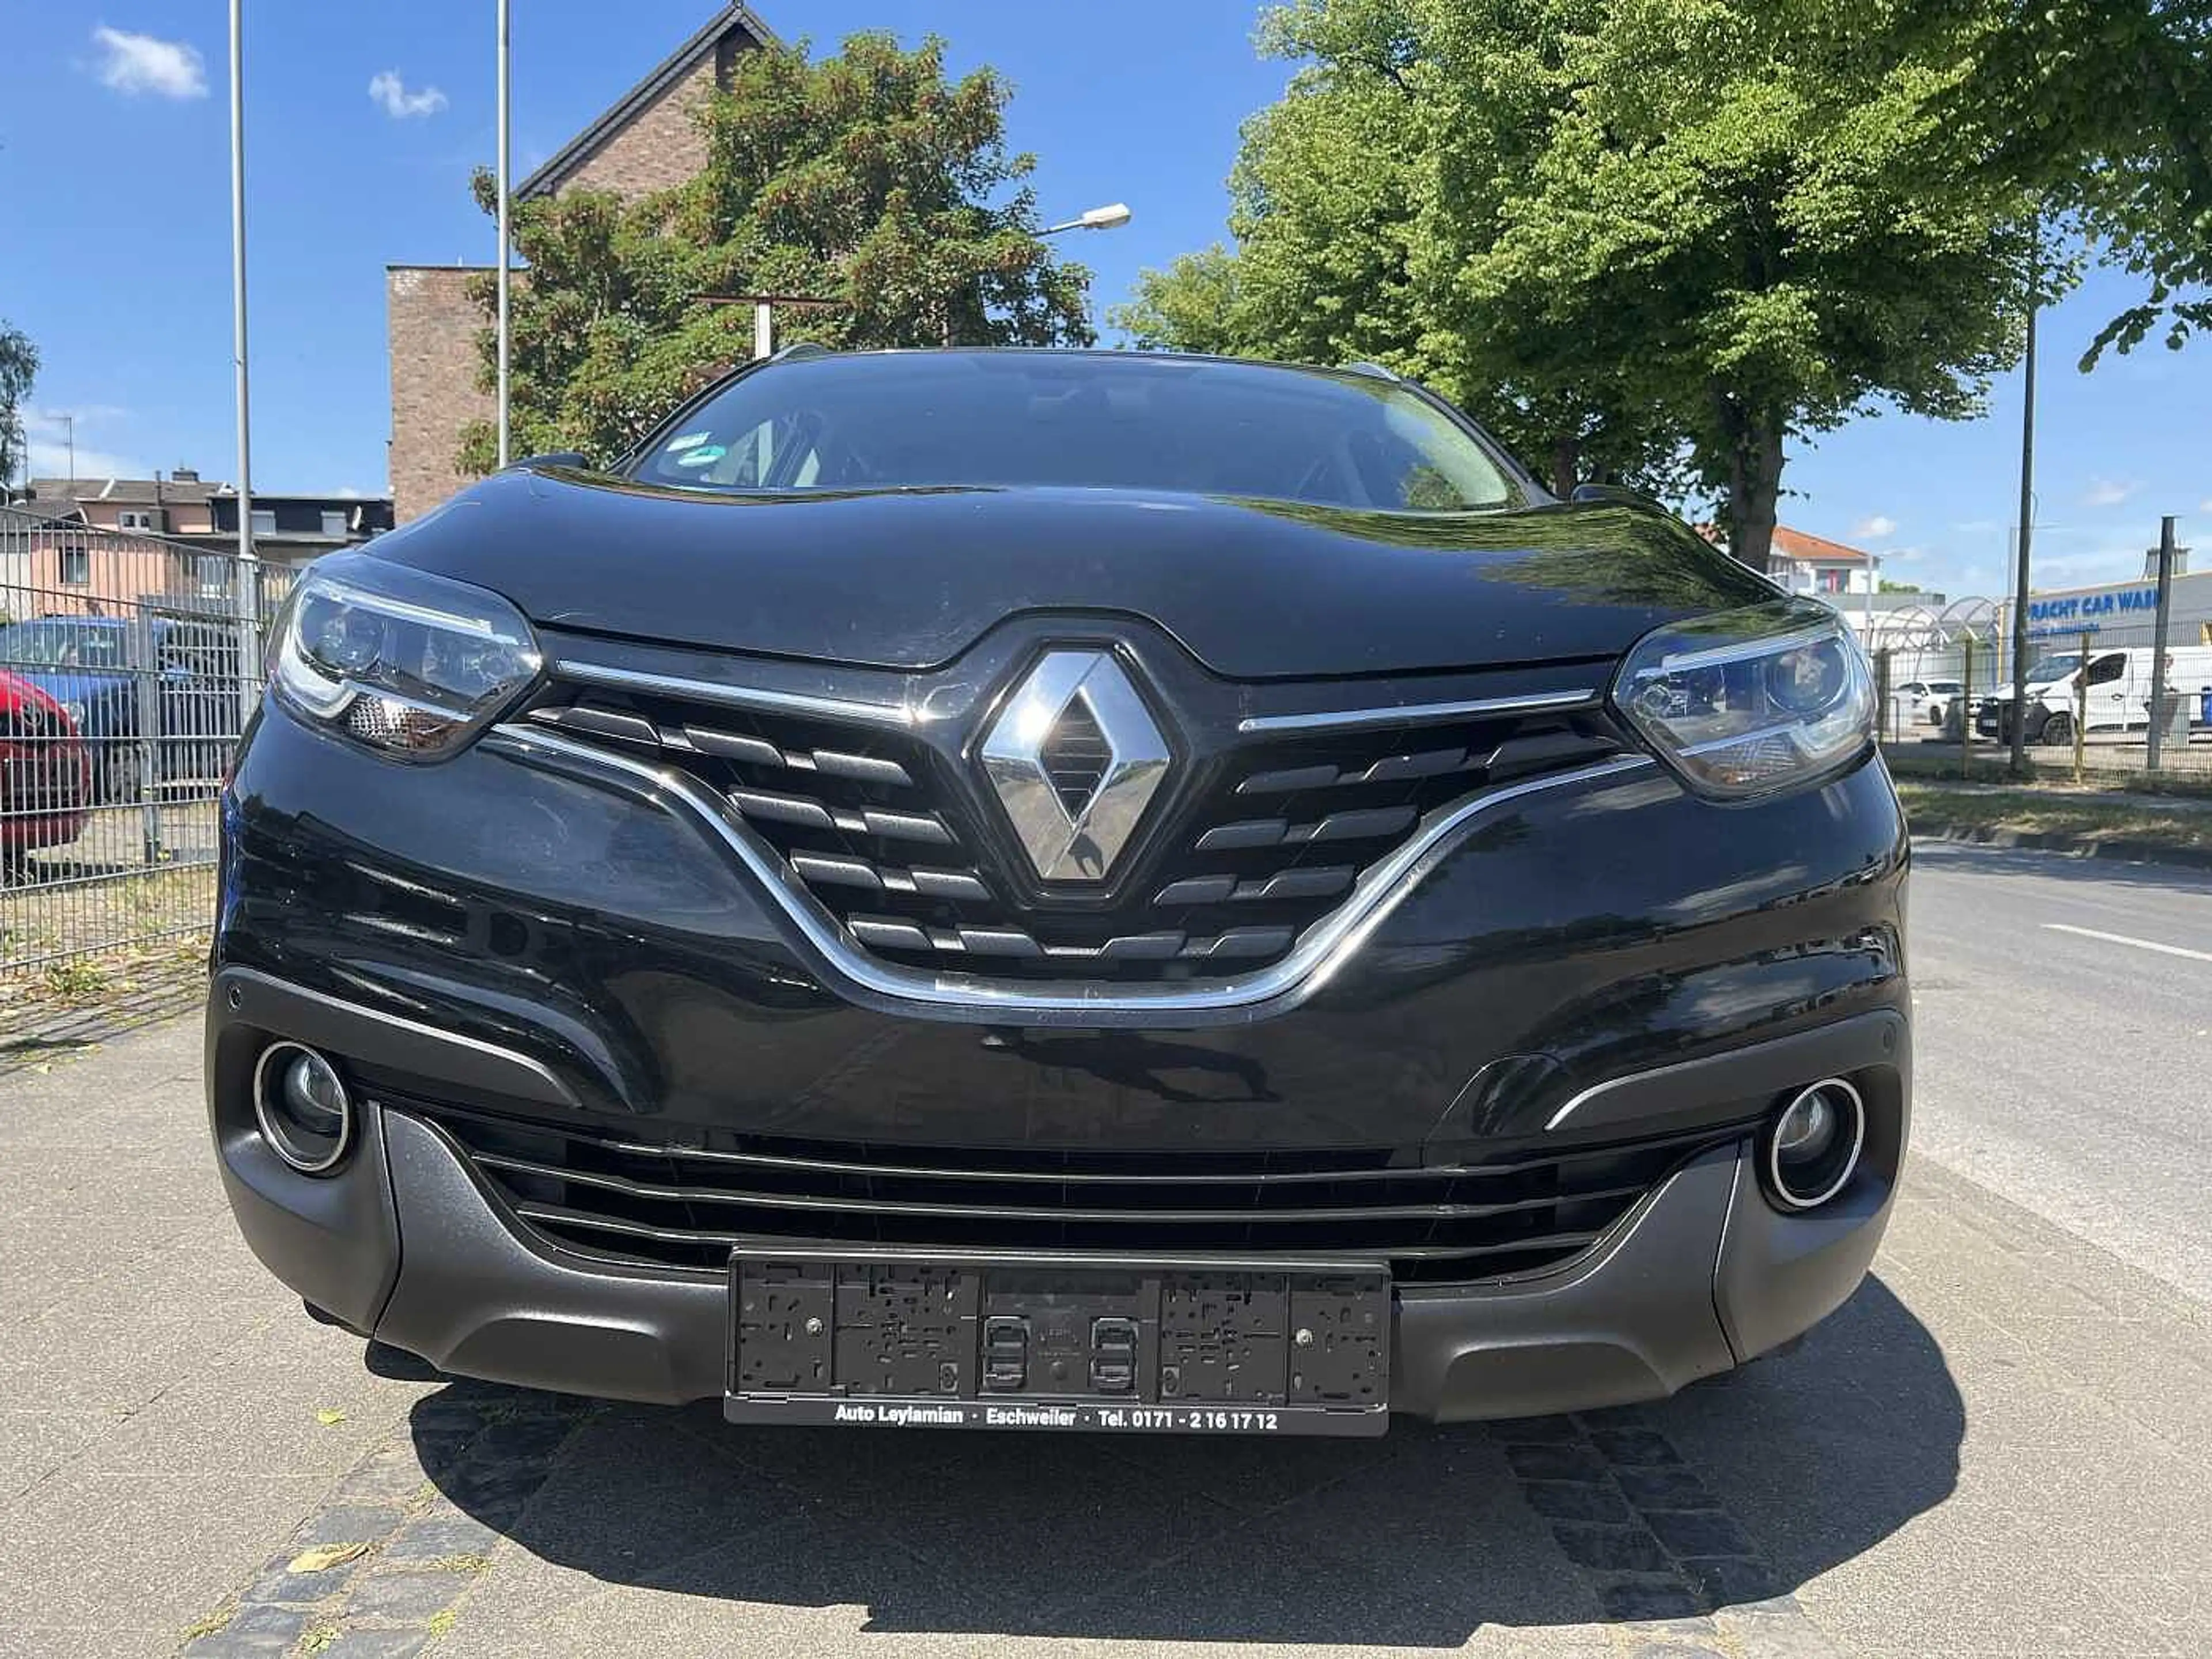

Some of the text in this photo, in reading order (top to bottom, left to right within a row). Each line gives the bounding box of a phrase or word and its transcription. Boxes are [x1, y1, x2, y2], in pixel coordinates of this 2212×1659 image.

[2029, 597, 2080, 620] RACHT
[2082, 593, 2113, 615] CAR
[835, 1404, 875, 1421] Auto
[878, 1405, 964, 1426] Leylamian
[986, 1407, 1077, 1426] Eschweiler
[1098, 1409, 1127, 1427] Tel.
[1132, 1410, 1172, 1428] 0171
